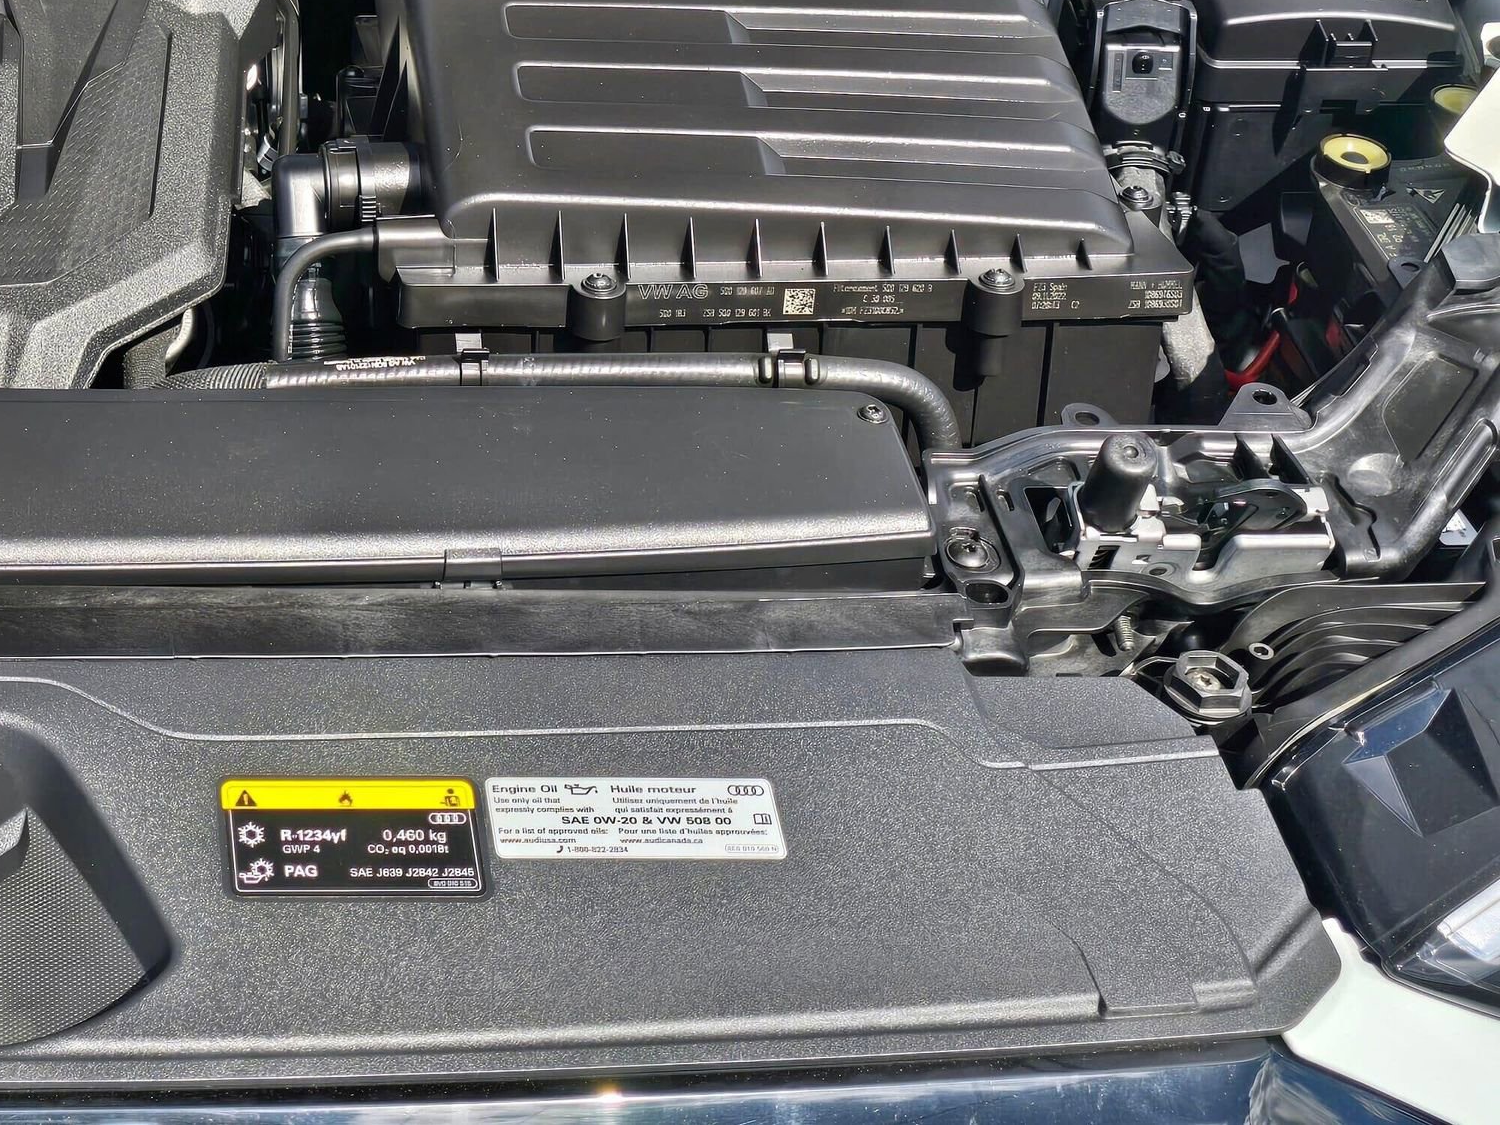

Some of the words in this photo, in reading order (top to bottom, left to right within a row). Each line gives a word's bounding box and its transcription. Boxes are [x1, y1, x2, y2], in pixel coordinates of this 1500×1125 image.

[638, 284, 673, 299] VW
[676, 284, 708, 299] AG
[1050, 283, 1067, 292] Spain
[492, 785, 536, 794] Engine
[540, 785, 558, 793] Oil
[610, 785, 643, 793] Huile
[280, 829, 347, 843] R-1234yf
[382, 829, 424, 842] 0,460
[429, 829, 447, 843] kg
[283, 845, 310, 853] GWP
[313, 845, 320, 853] 4
[409, 845, 449, 853] 0,0018t
[284, 865, 318, 877] PAG
[350, 868, 373, 877] SAE
[376, 868, 402, 877] J639
[406, 868, 439, 877] J2842
